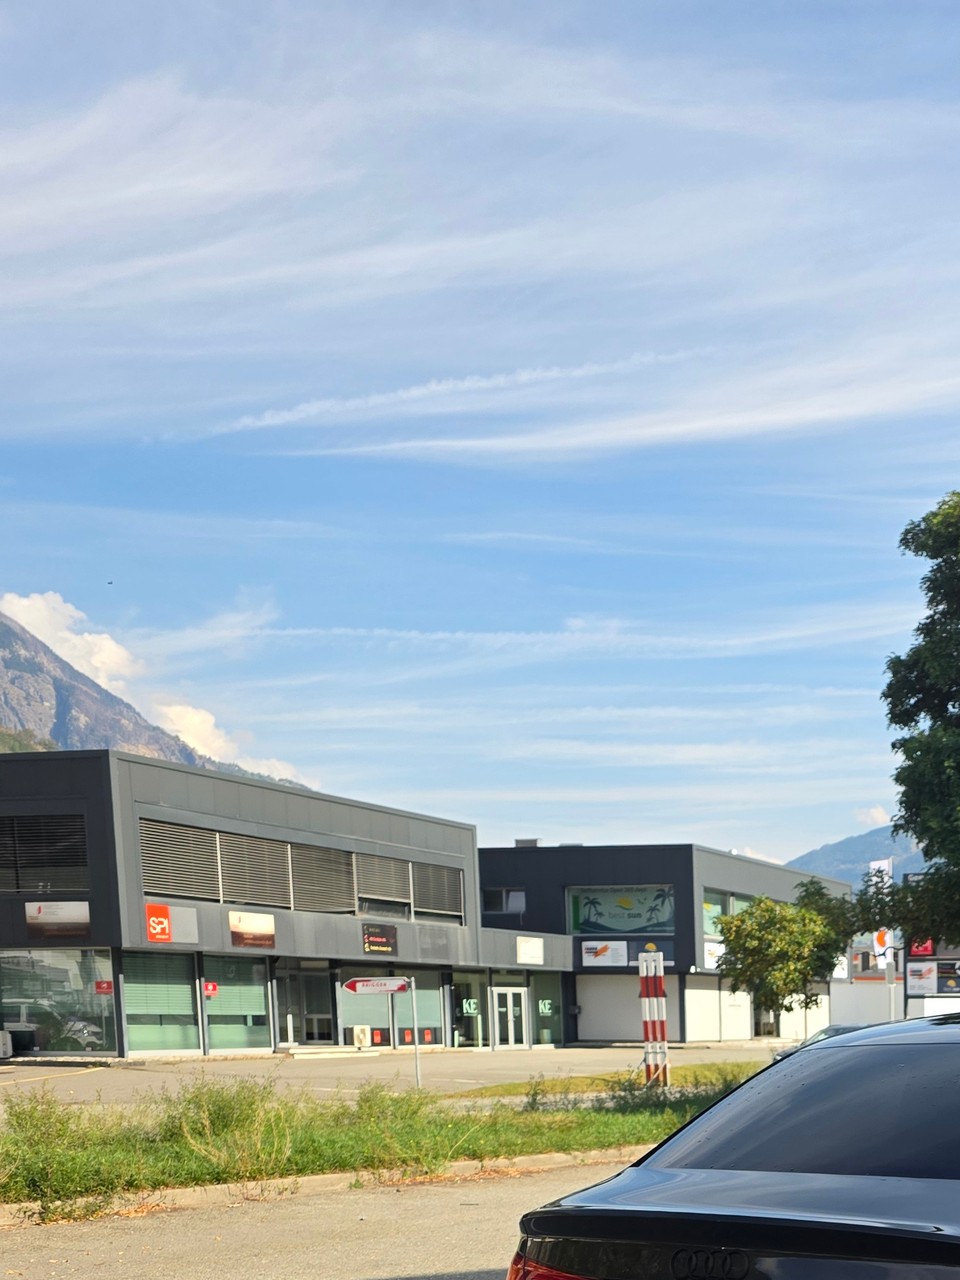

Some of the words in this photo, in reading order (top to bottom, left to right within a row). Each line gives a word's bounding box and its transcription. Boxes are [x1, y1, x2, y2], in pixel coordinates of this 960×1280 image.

[150, 917, 169, 934] SPI
[462, 999, 478, 1014] KE
[538, 1000, 552, 1013] KE
